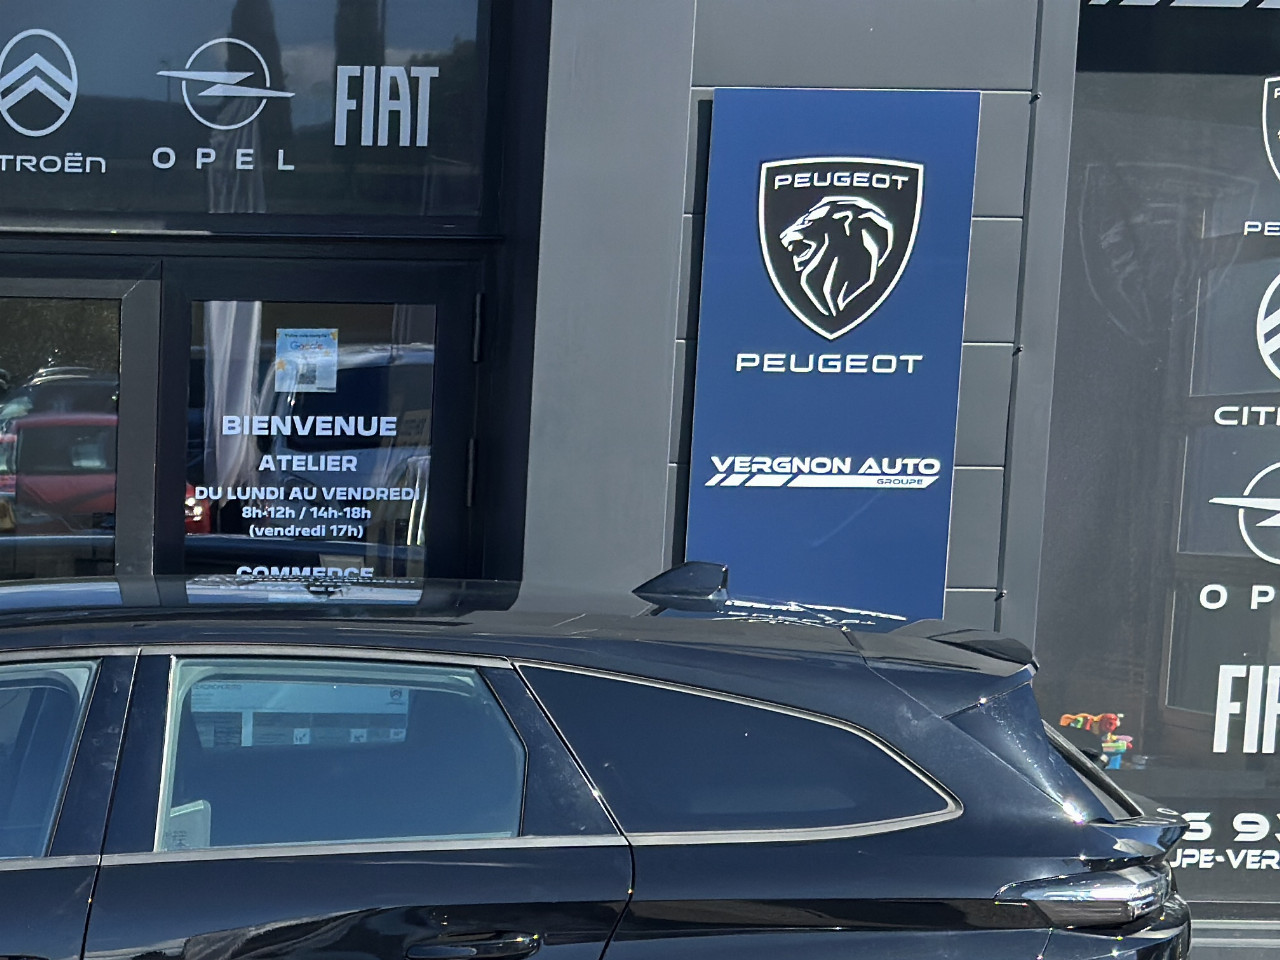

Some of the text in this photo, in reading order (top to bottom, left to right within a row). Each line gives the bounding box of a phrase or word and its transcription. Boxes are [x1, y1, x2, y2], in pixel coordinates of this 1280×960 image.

[335, 66, 439, 147] FIAT
[152, 146, 295, 171] OPEL
[774, 172, 909, 192] PEUGEOT
[736, 353, 923, 374] PEUGEOT
[222, 415, 397, 436] BIENVENUE
[1214, 407, 1280, 425] CIT
[259, 454, 357, 472] ATELIER
[710, 456, 941, 476] VERGNON AUTO
[877, 478, 924, 486] GROUPE
[195, 486, 419, 501] DU LUNDI AU VENDREDI
[310, 507, 371, 519] 14h-18h
[249, 524, 364, 538] (vendredi 17h)
[1232, 812, 1280, 842] 9
